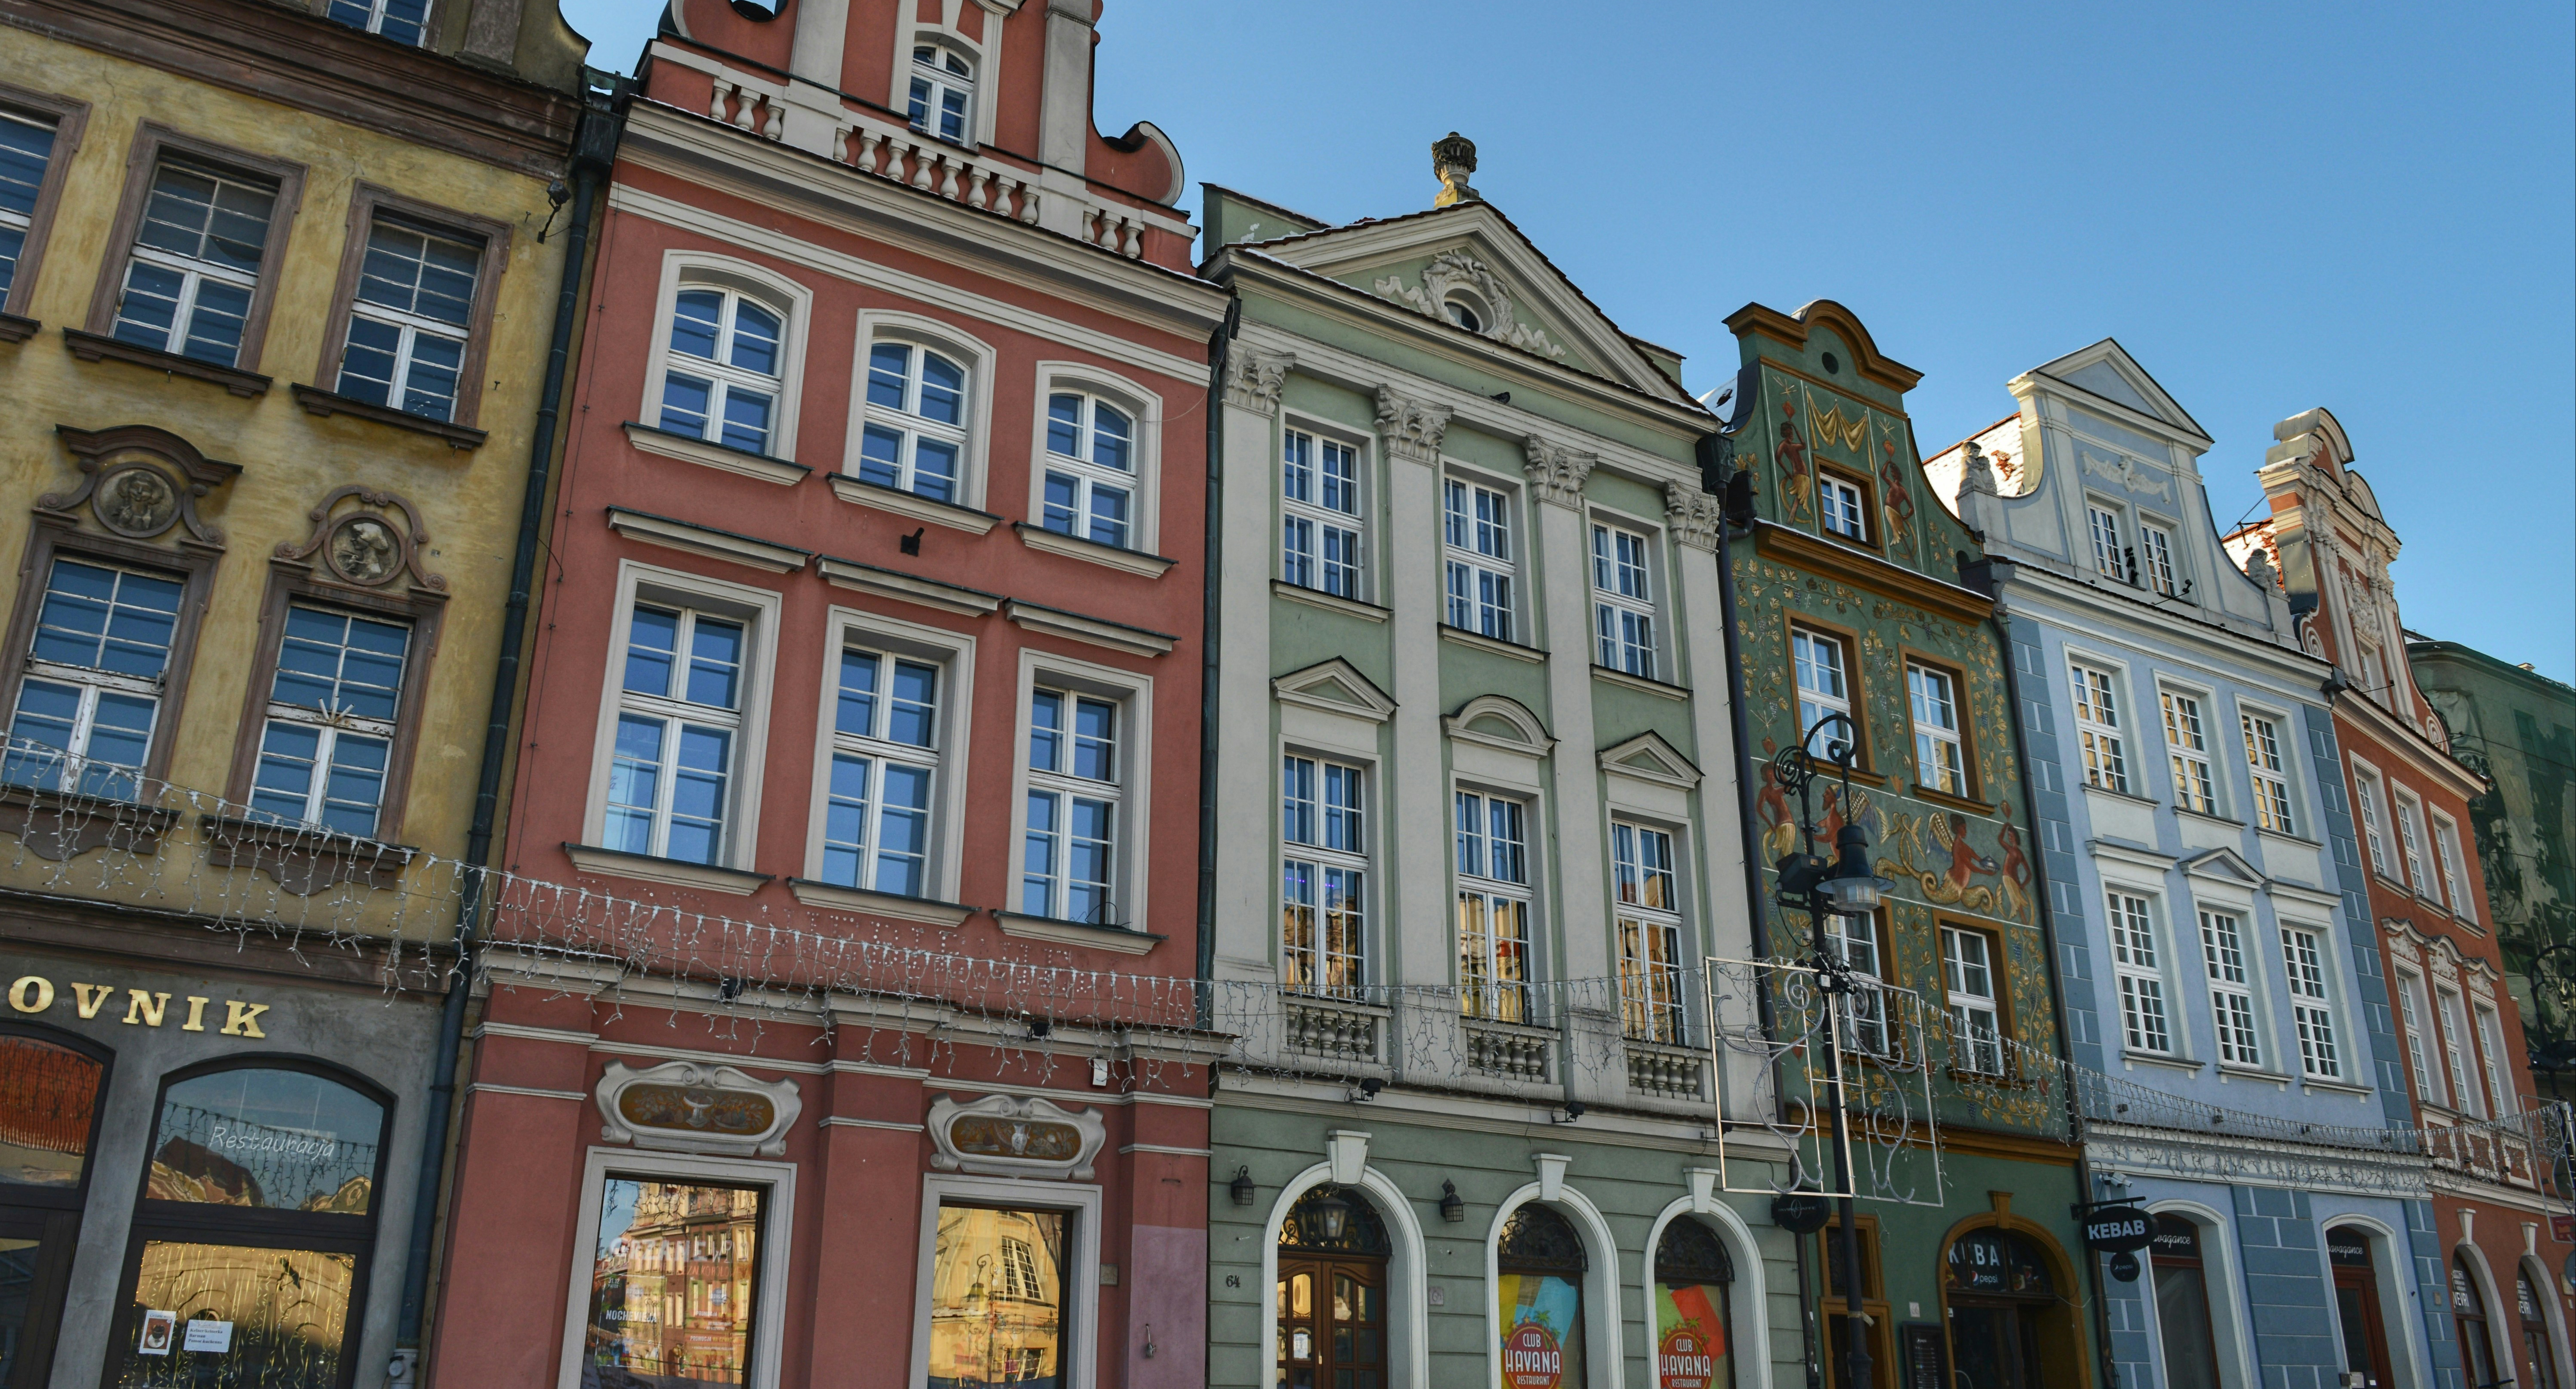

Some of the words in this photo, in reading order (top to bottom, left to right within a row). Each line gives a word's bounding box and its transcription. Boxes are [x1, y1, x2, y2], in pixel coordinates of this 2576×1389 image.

[8, 976, 270, 1038] OVNIK
[209, 1127, 334, 1160] Restauracja
[2088, 1220, 2145, 1240] KEBAB
[609, 1237, 708, 1261] GRZANE
[1948, 1243, 2013, 1266] KBA
[1226, 1275, 1240, 1288] 64
[1979, 1274, 1998, 1284] pepsi
[1523, 1333, 1541, 1347] CLUB
[1676, 1339, 1693, 1352] CLUB
[1505, 1349, 1560, 1373] HAVANA
[1660, 1354, 1711, 1377] HAVANA
[1516, 1375, 1550, 1386] RESTAURANT
[1672, 1379, 1702, 1388] RESTAURANT
